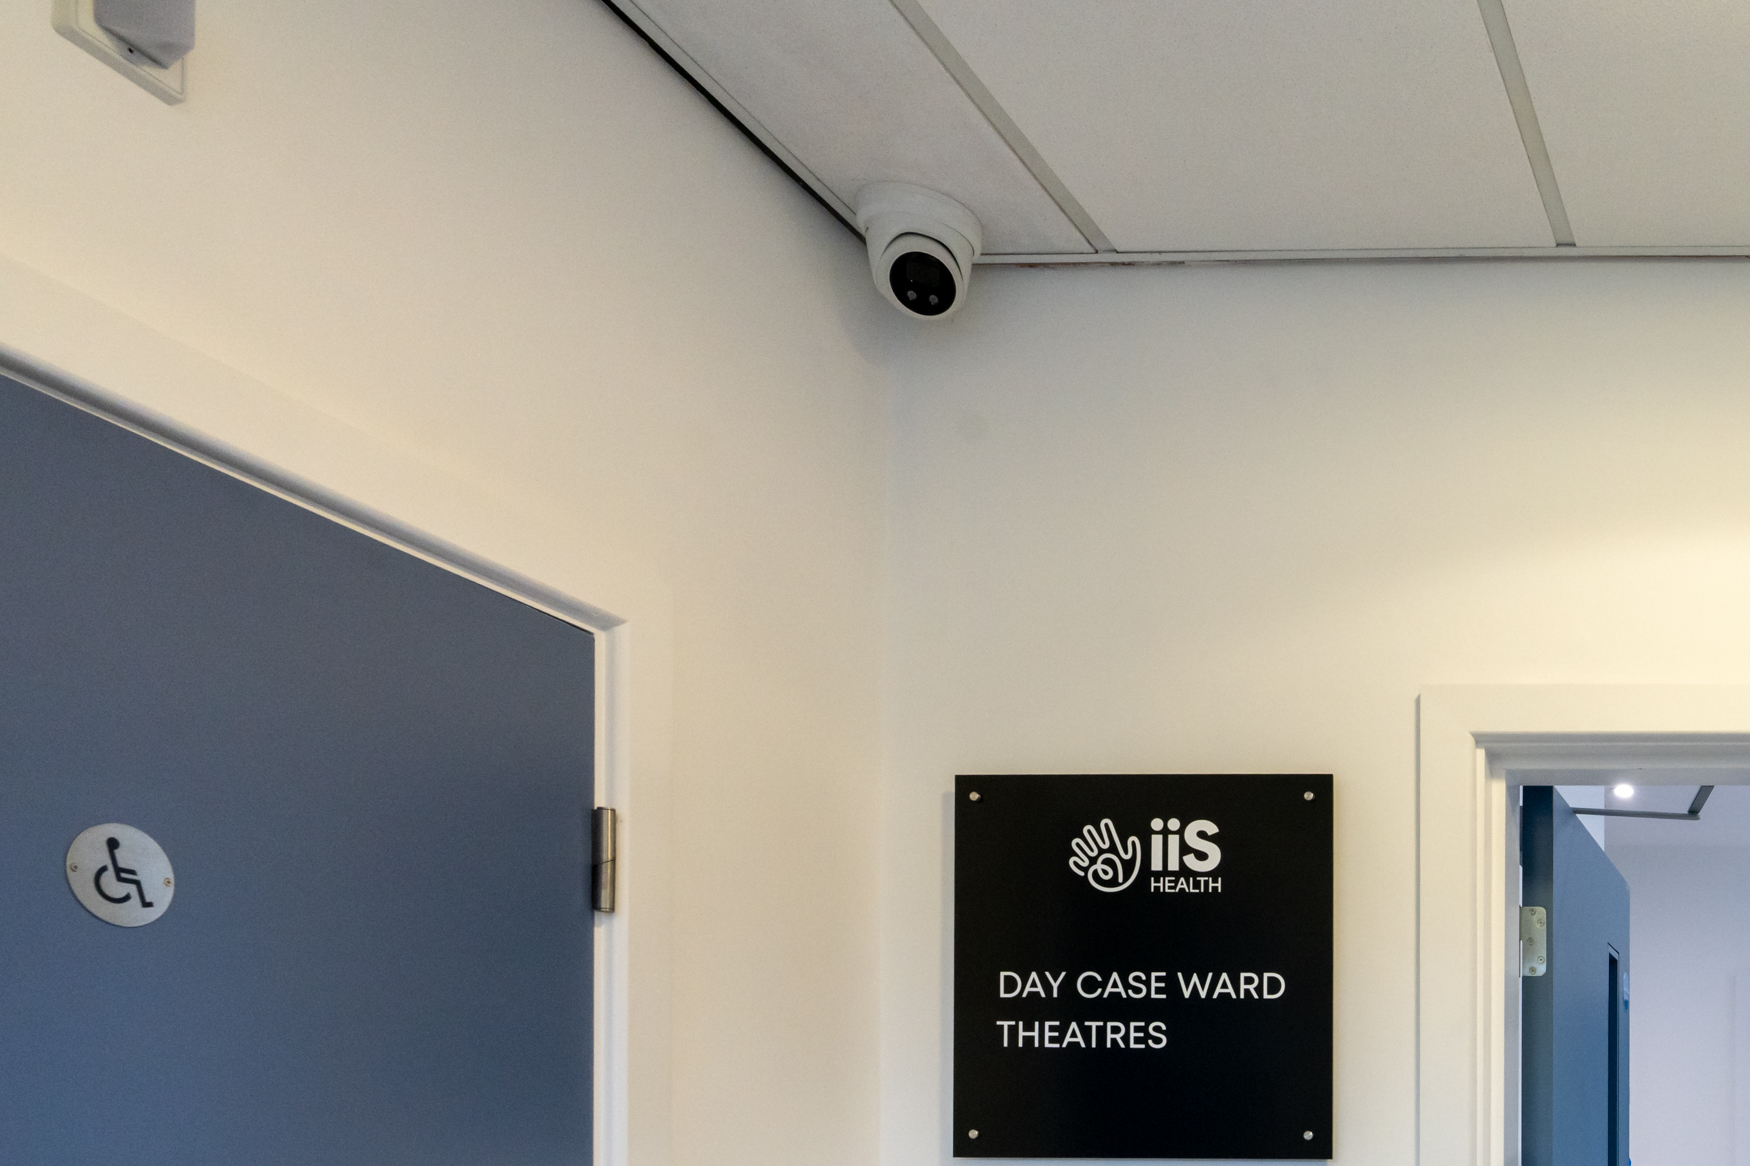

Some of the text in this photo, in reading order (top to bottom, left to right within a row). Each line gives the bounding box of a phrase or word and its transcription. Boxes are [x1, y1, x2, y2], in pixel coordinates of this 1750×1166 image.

[1150, 817, 1222, 873] iiS
[1150, 876, 1222, 893] HEALTH
[999, 970, 1286, 1000] DAY CASE WARD
[996, 1020, 1168, 1049] THEATRES
